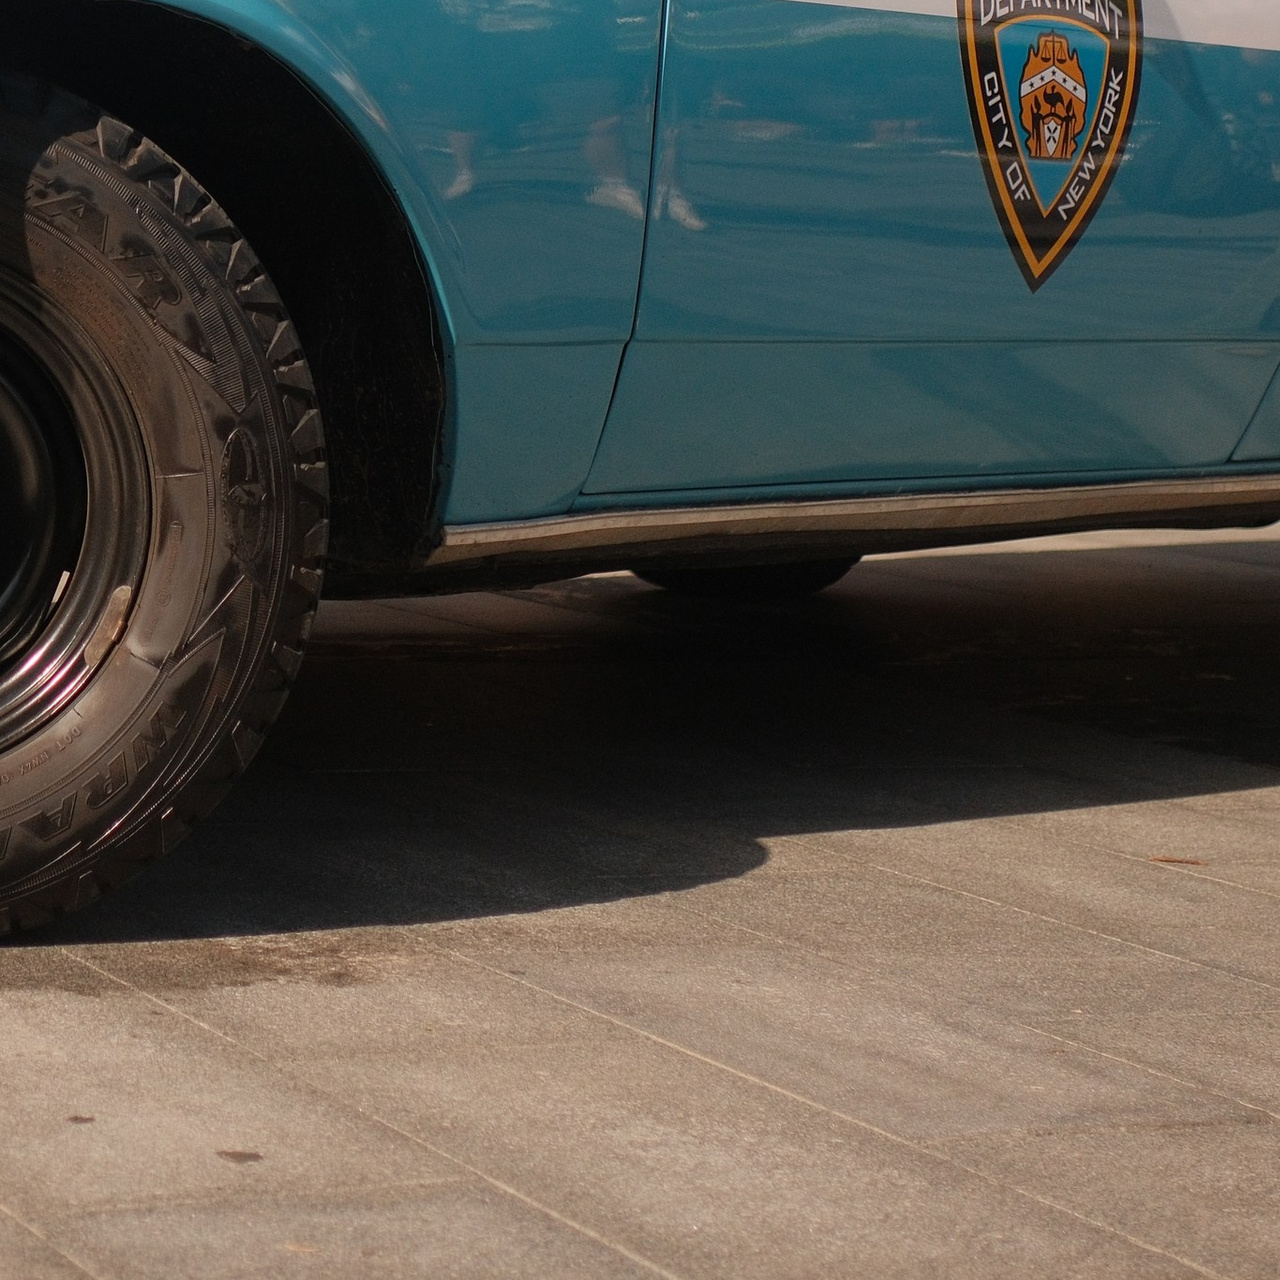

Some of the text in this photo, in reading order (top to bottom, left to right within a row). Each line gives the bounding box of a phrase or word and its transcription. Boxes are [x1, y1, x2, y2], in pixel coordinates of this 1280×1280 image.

[983, 71, 1031, 202] CITY OF
[1057, 69, 1123, 221] NEW YORK
